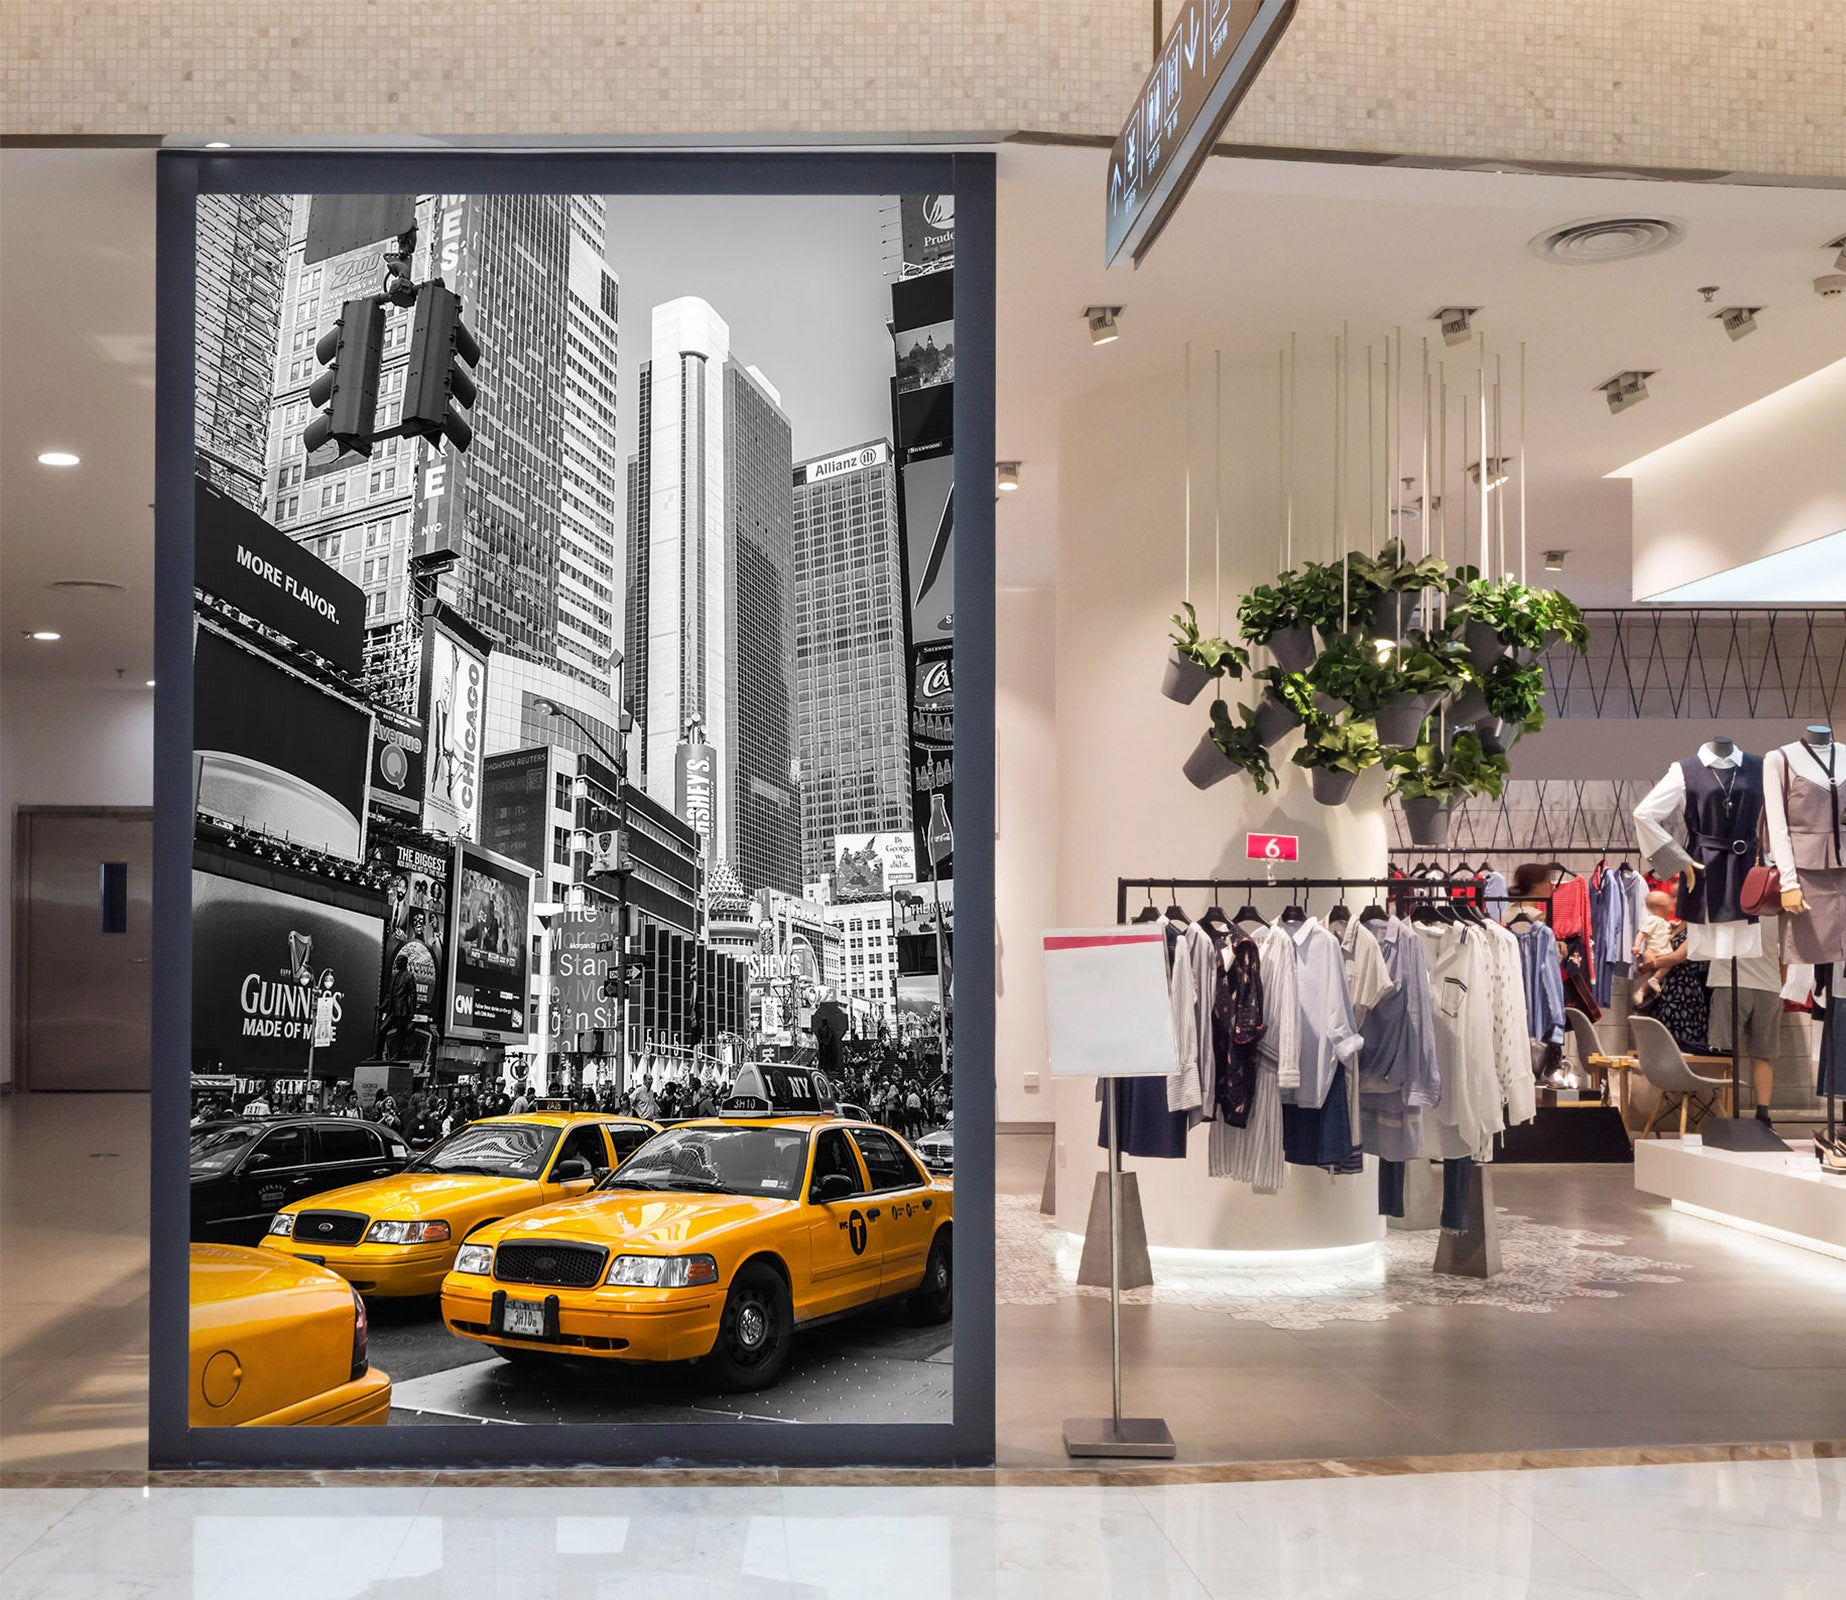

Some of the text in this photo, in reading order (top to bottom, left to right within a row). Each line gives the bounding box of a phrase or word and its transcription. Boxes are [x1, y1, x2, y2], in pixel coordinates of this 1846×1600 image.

[815, 456, 857, 477] Allianz
[421, 522, 443, 536] NYC
[237, 545, 339, 625] MORE FLAVOR.
[374, 718, 423, 754] Avenue
[461, 663, 480, 809] CHICAGO
[381, 743, 408, 790] Q
[516, 753, 547, 767] REUTERS
[396, 845, 446, 873] THE BIGGEST
[1265, 837, 1281, 858] 6
[910, 903, 928, 916] THE
[241, 973, 342, 1023] GUINNS
[455, 994, 473, 1015] CNN
[242, 1018, 282, 1037] MADE
[284, 1021, 301, 1039] OF
[303, 1023, 336, 1042] ME
[765, 1074, 811, 1098] I NY
[734, 1098, 756, 1110] 3H10
[852, 1218, 862, 1250] T
